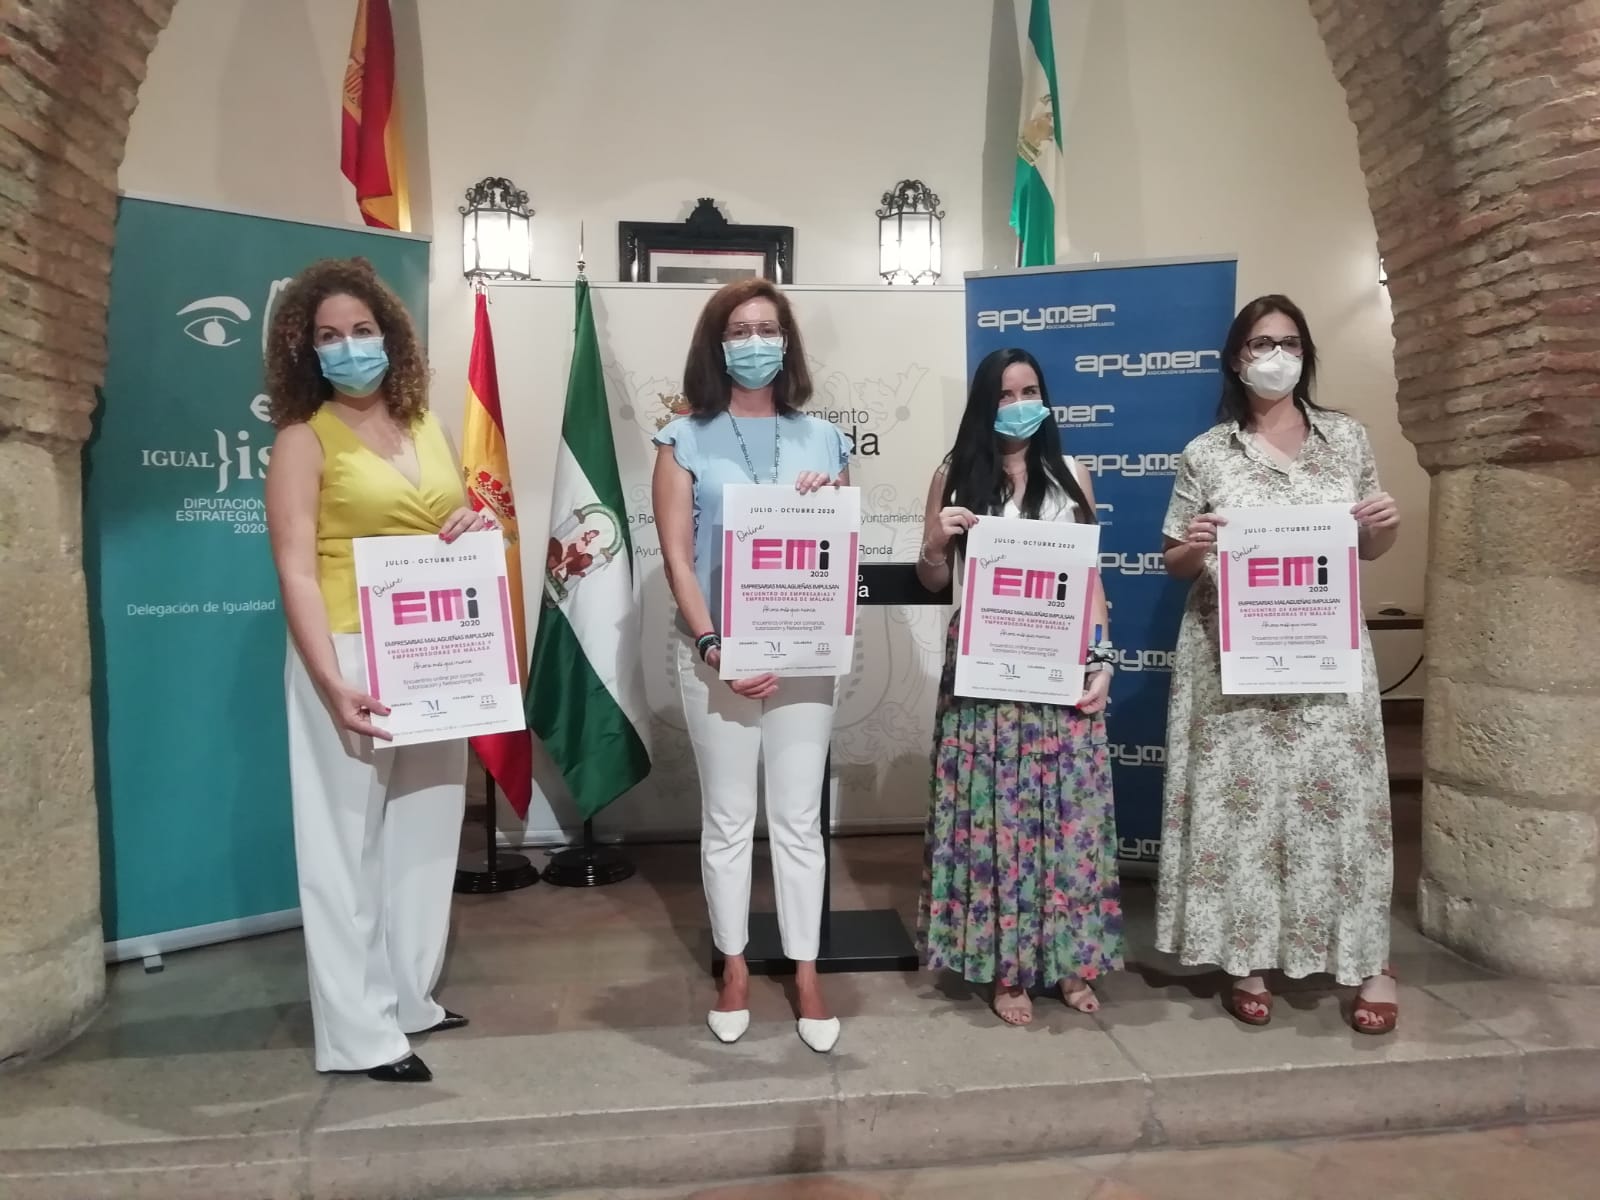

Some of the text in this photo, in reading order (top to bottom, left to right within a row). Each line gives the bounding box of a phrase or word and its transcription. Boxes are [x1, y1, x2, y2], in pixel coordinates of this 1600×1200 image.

[977, 304, 1116, 332] apymer
[1075, 350, 1220, 377] apymer
[141, 450, 215, 468] IGUAL
[175, 510, 260, 521] ESTRATEGIA
[127, 599, 276, 617] Delegación de Igualdad
[460, 619, 481, 628] 2020
